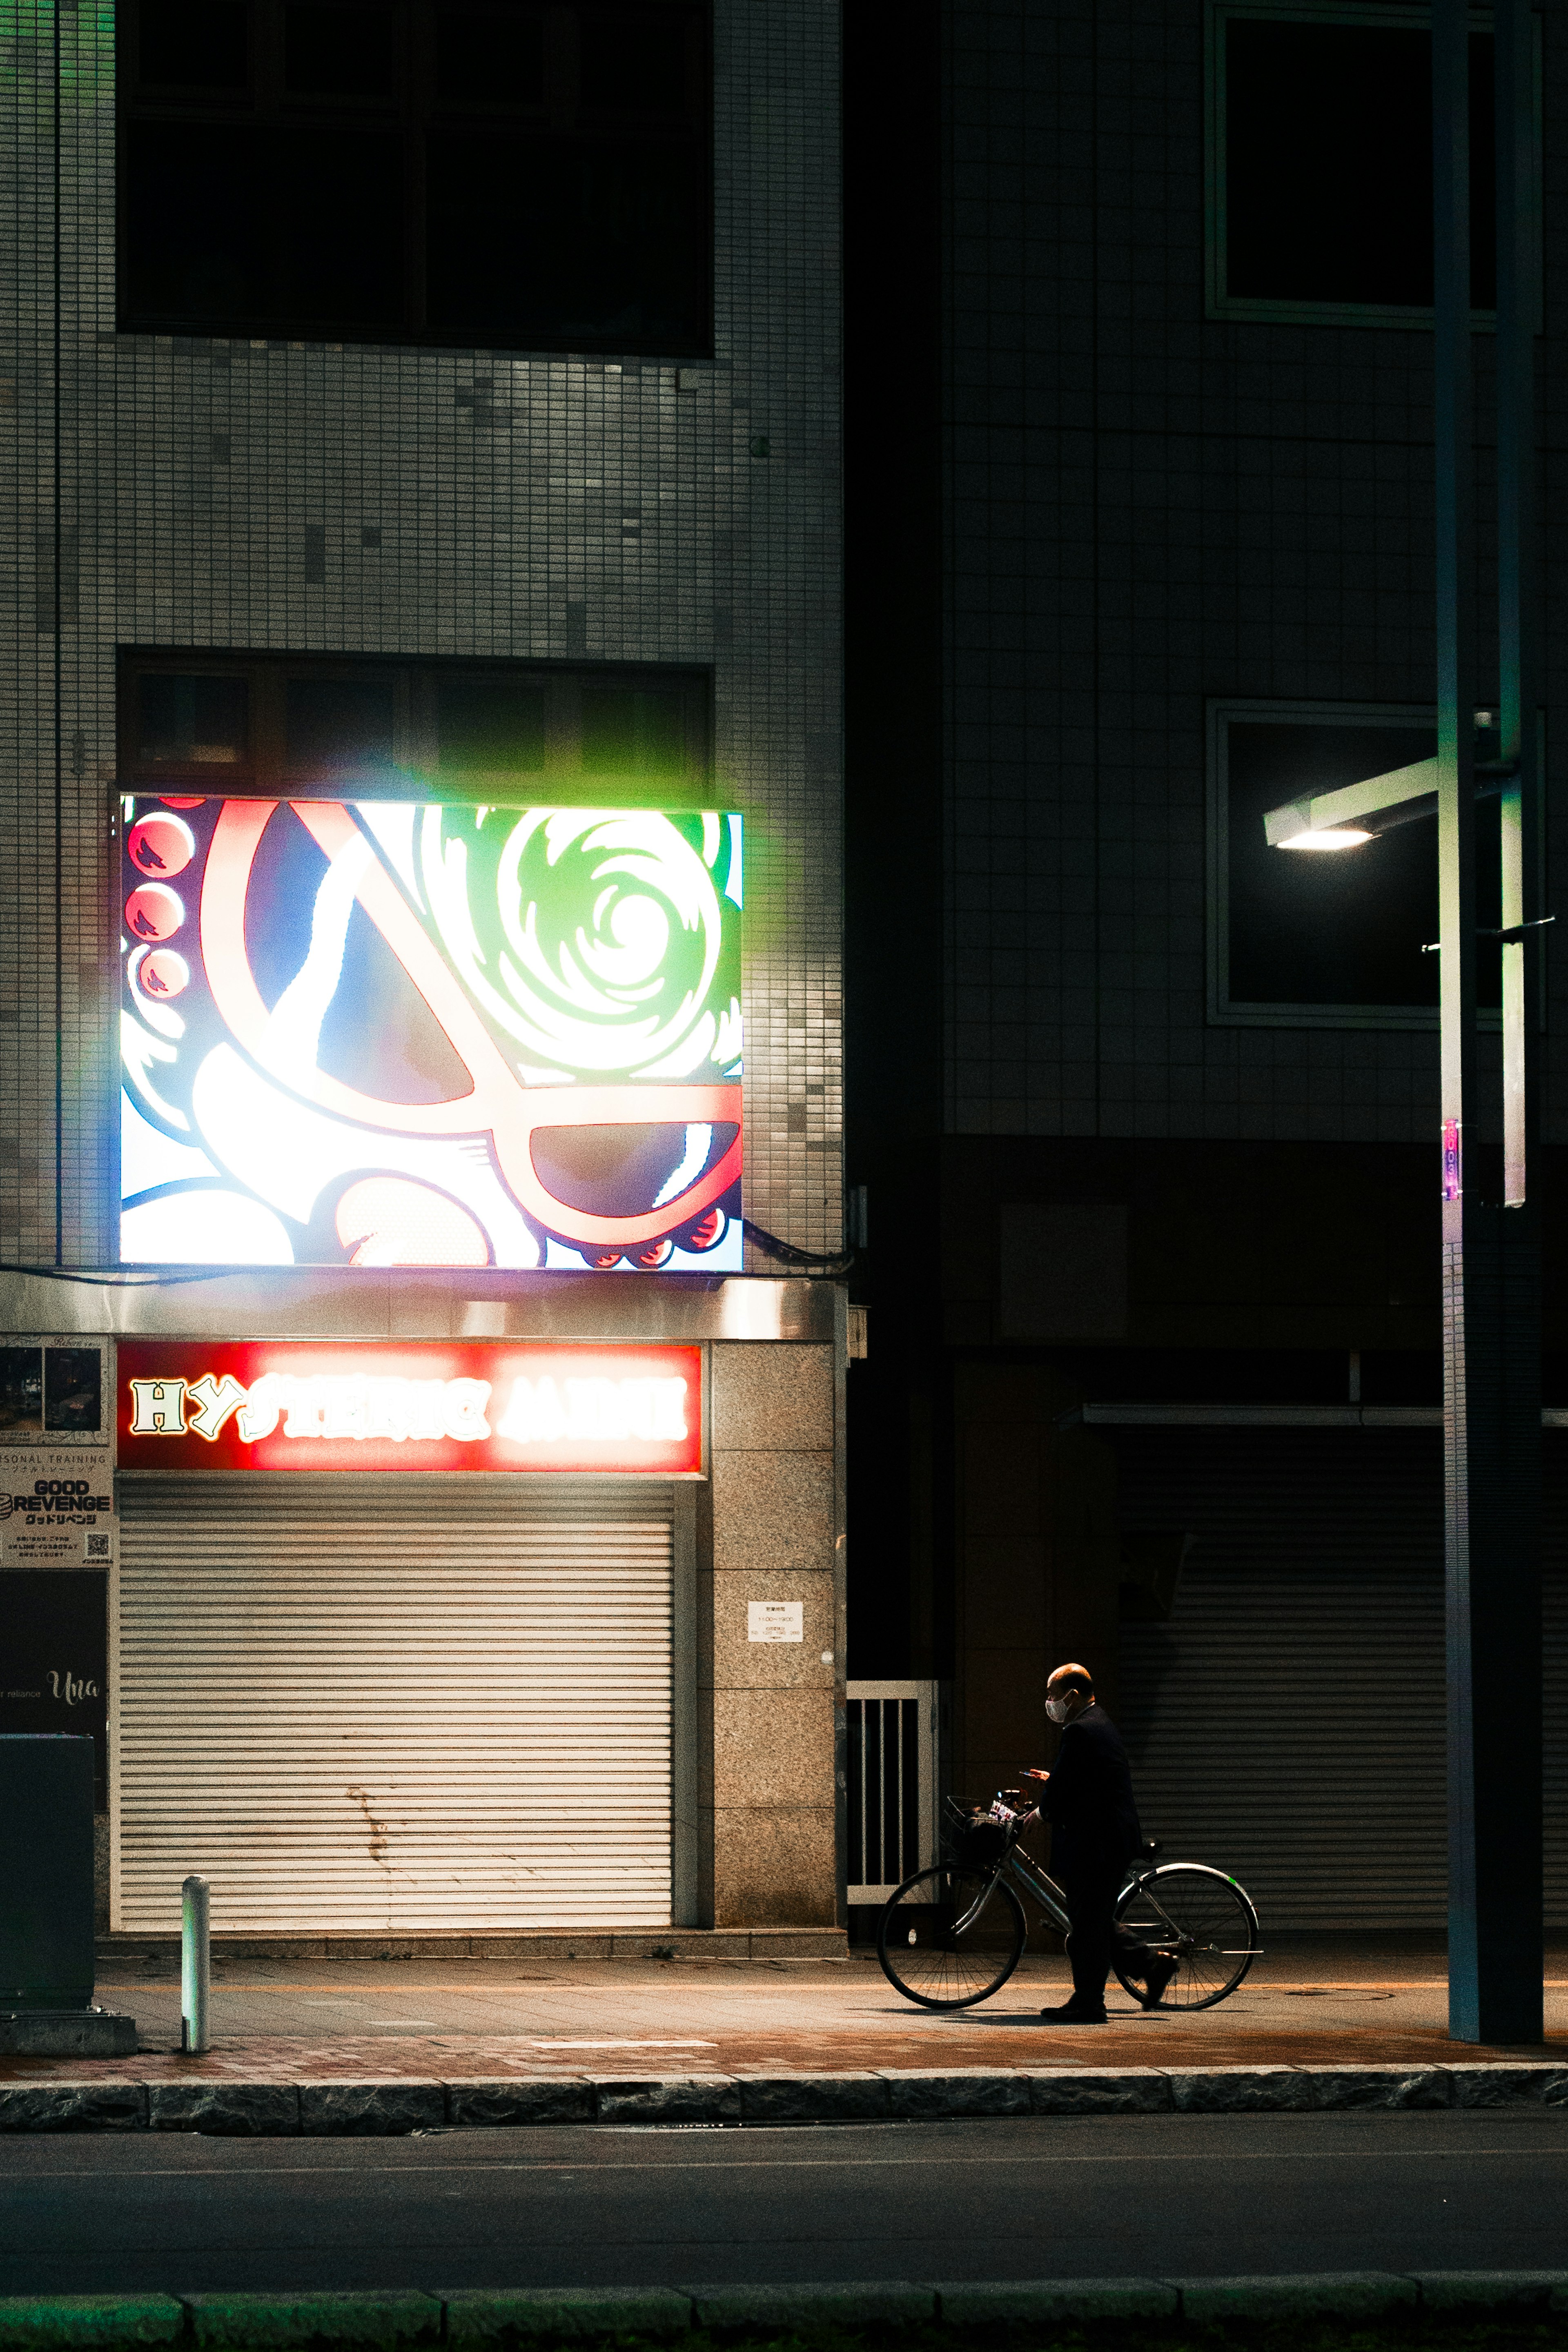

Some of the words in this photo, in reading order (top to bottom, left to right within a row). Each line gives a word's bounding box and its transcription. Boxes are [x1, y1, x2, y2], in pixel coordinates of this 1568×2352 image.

[130, 1373, 491, 1441] HYSTERIC
[0, 1455, 41, 1463] SONAL
[49, 1455, 106, 1464] TRAINING
[34, 1480, 89, 1495] GOOD
[14, 1496, 110, 1511] REVENGE
[26, 1514, 96, 1525] グッドリベンジ
[7, 1690, 41, 1698] reliance
[47, 1670, 100, 1706] Una
